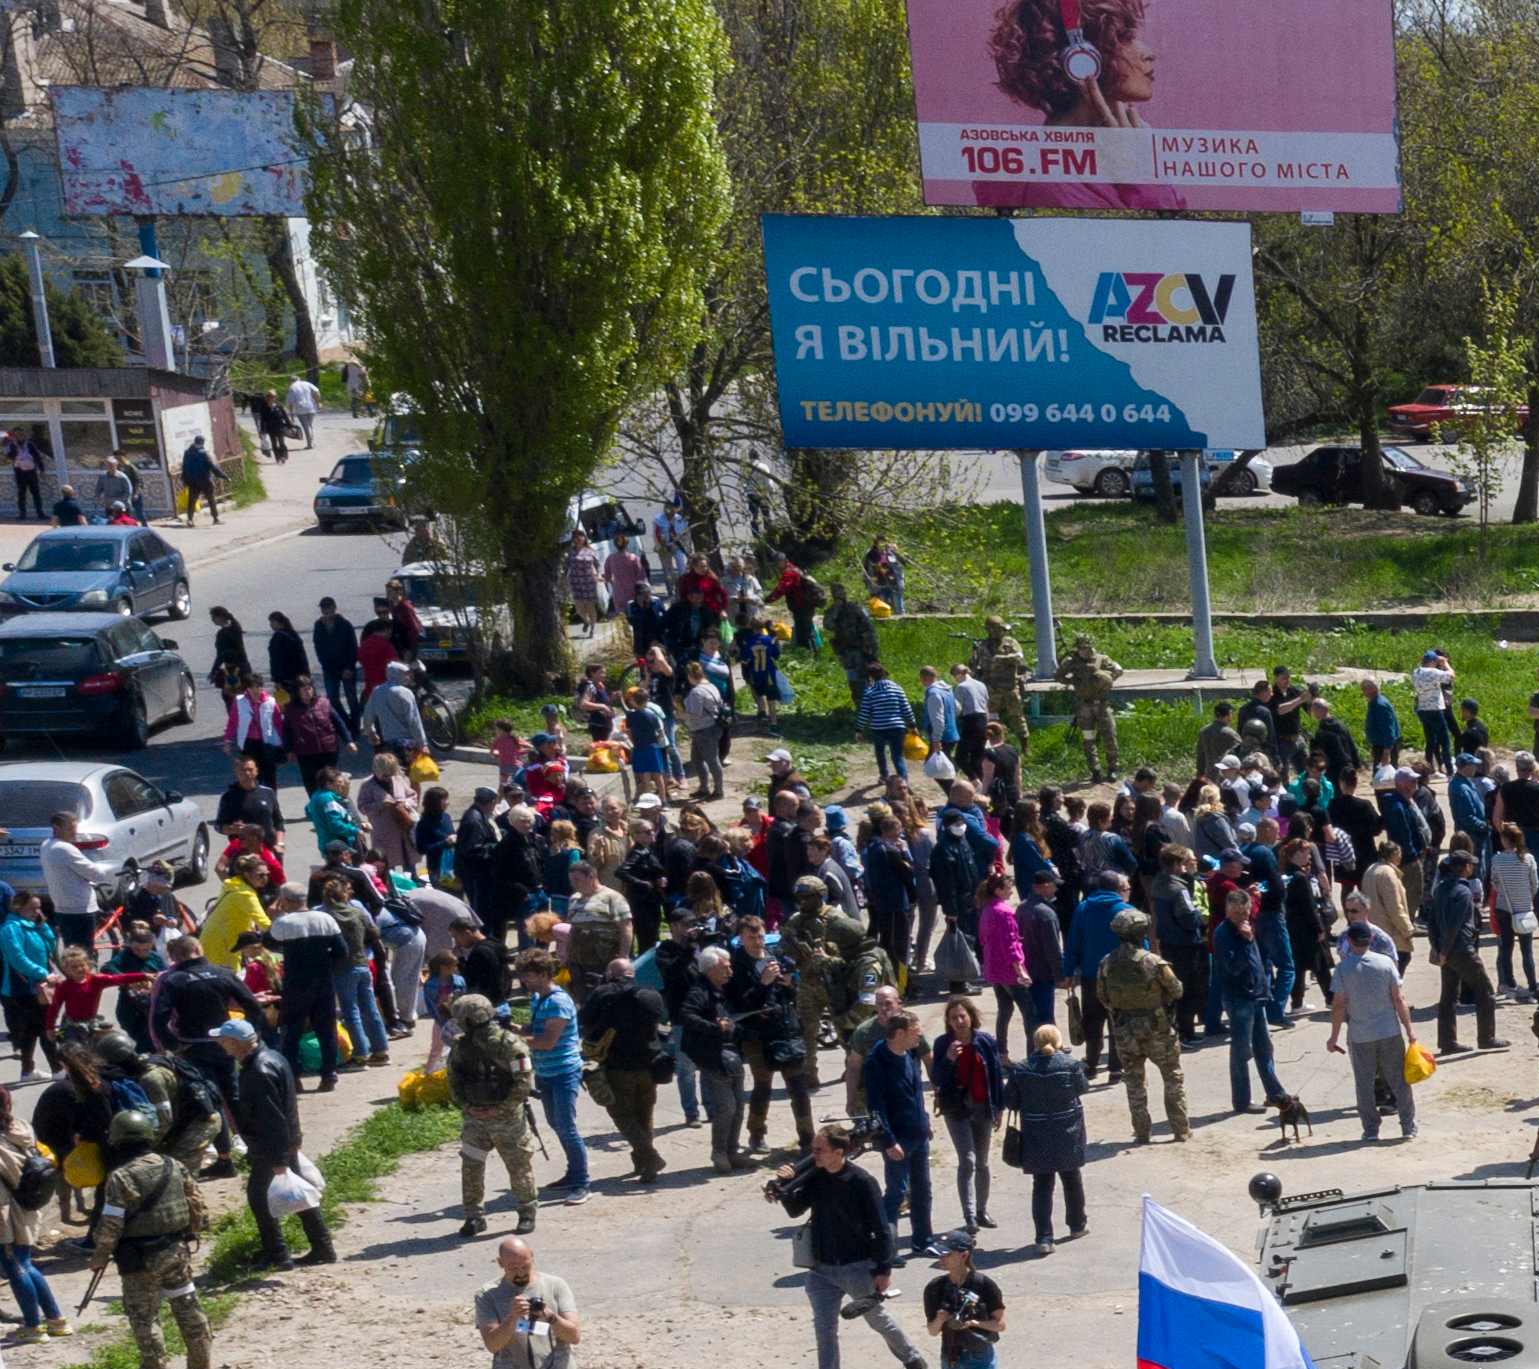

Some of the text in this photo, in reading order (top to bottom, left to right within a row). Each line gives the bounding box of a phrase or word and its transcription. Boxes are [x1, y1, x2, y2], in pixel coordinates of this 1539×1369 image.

[960, 129, 1096, 143] АЗОВСЬКА ХВИЛЯ
[1162, 136, 1259, 154] МУЗИКА
[1163, 161, 1350, 180] НАШОГО МІСТА
[789, 266, 1036, 313] СЬОГОДНІ
[794, 320, 1070, 362] Я ВІЛЬНИЙ!
[1103, 325, 1227, 343] RECLAMA
[800, 399, 1172, 423] ТЕЛЕФОНУЙ! 099 644 0 644
